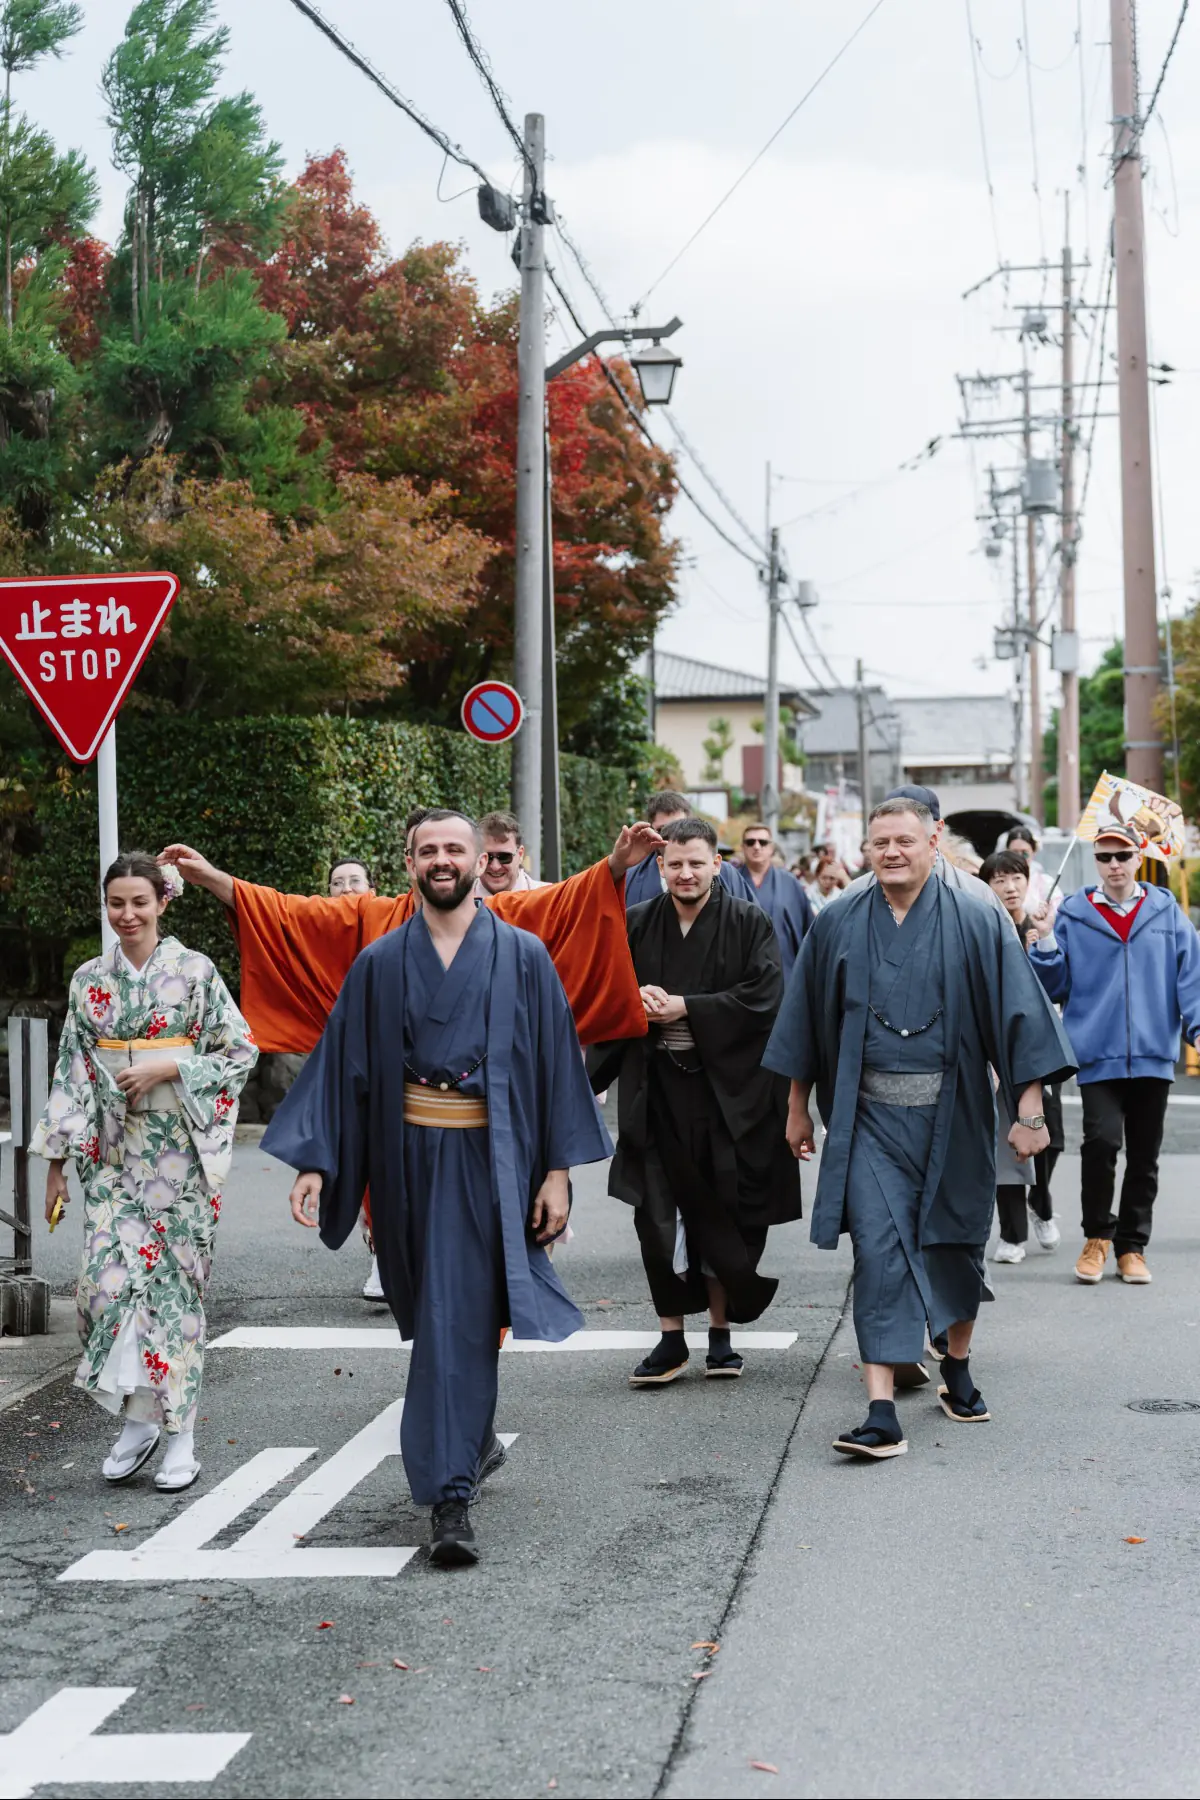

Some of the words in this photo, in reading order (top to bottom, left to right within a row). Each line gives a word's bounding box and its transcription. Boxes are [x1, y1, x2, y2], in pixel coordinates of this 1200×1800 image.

[15, 597, 137, 641] 止まれ
[39, 648, 121, 682] STOP
